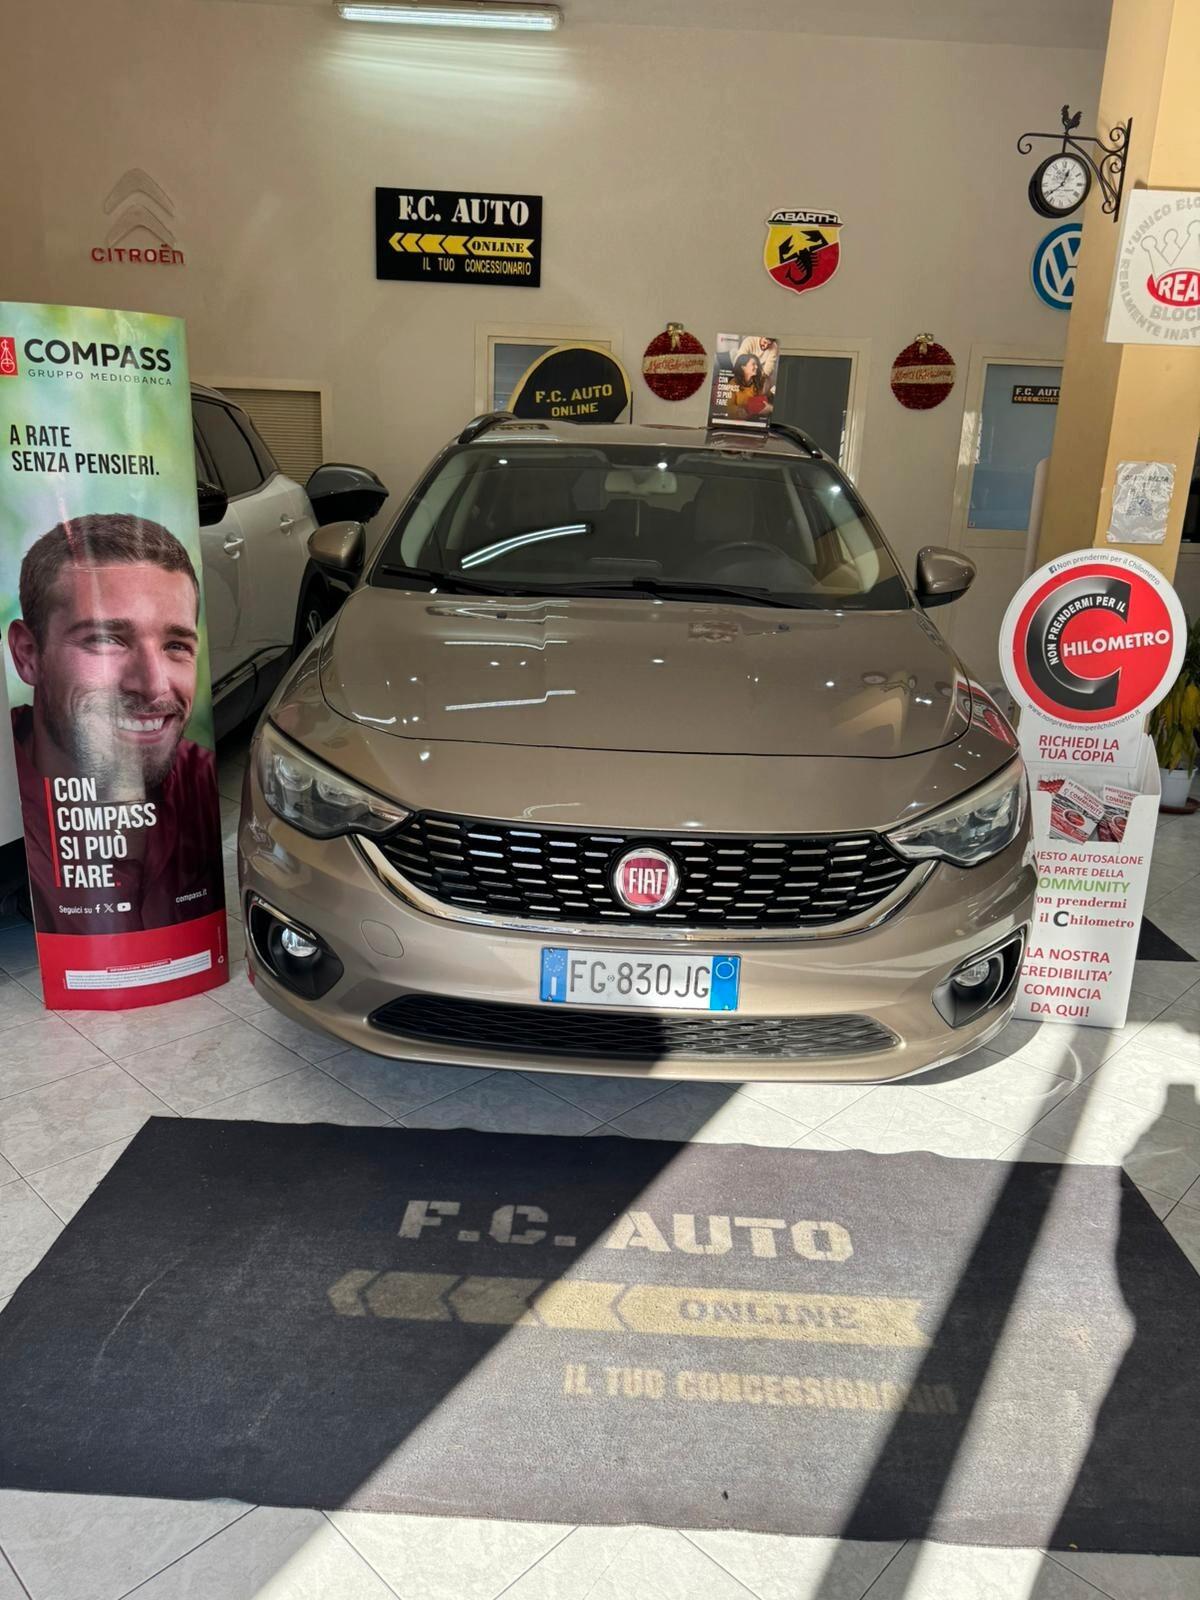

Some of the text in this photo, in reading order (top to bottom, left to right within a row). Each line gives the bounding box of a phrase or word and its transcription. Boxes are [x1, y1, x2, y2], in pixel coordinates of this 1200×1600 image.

[397, 195, 530, 227] F.C. AUTO
[773, 212, 838, 223] ABARTH
[1126, 204, 1172, 256] L'UNICO
[471, 240, 525, 254] ONLINE
[422, 257, 532, 275] IL TUO CONCESSIONARIO
[23, 338, 172, 373] COMPASS
[27, 369, 173, 386] GRUPPO MEDIOBANCA
[535, 383, 613, 403] F.C. AUTO
[1015, 387, 1034, 396] F.C.
[551, 402, 599, 417] ONLINE
[9, 424, 72, 448] A RATE
[11, 450, 161, 476] SENZA PENSIERI.
[1056, 560, 1073, 570] Non
[1072, 553, 1110, 566] prendermi
[1110, 555, 1123, 563] per
[1127, 560, 1161, 586] Chilometro
[1047, 595, 1127, 666] NON PRENDERMI PER IL
[1038, 735, 1120, 751] RICHIEDI LA
[1040, 747, 1115, 763] TUA COPIA
[53, 777, 97, 802] CON
[57, 802, 158, 831] COMPASS
[59, 829, 128, 860] SI PUÒ
[1036, 851, 1144, 865] ESTO AUTOSALONE
[1038, 864, 1125, 879] FA PARTE DELLA
[628, 867, 666, 895] FIAT
[1039, 876, 1131, 893] OMMUNITY
[175, 888, 208, 904] compass.it
[1036, 893, 1127, 909] on prendermi
[59, 904, 93, 915] Seguici su
[1039, 910, 1135, 928] il Chilometro
[1026, 947, 1110, 964] LA NOSTRA
[1024, 983, 1102, 1000] COMINCIA
[1030, 1002, 1090, 1018] DA QUI!
[397, 1199, 855, 1263] F.C. AUTO
[678, 1297, 858, 1330] ONLINE
[561, 1363, 592, 1397] IL
[605, 1364, 667, 1400] TUO
